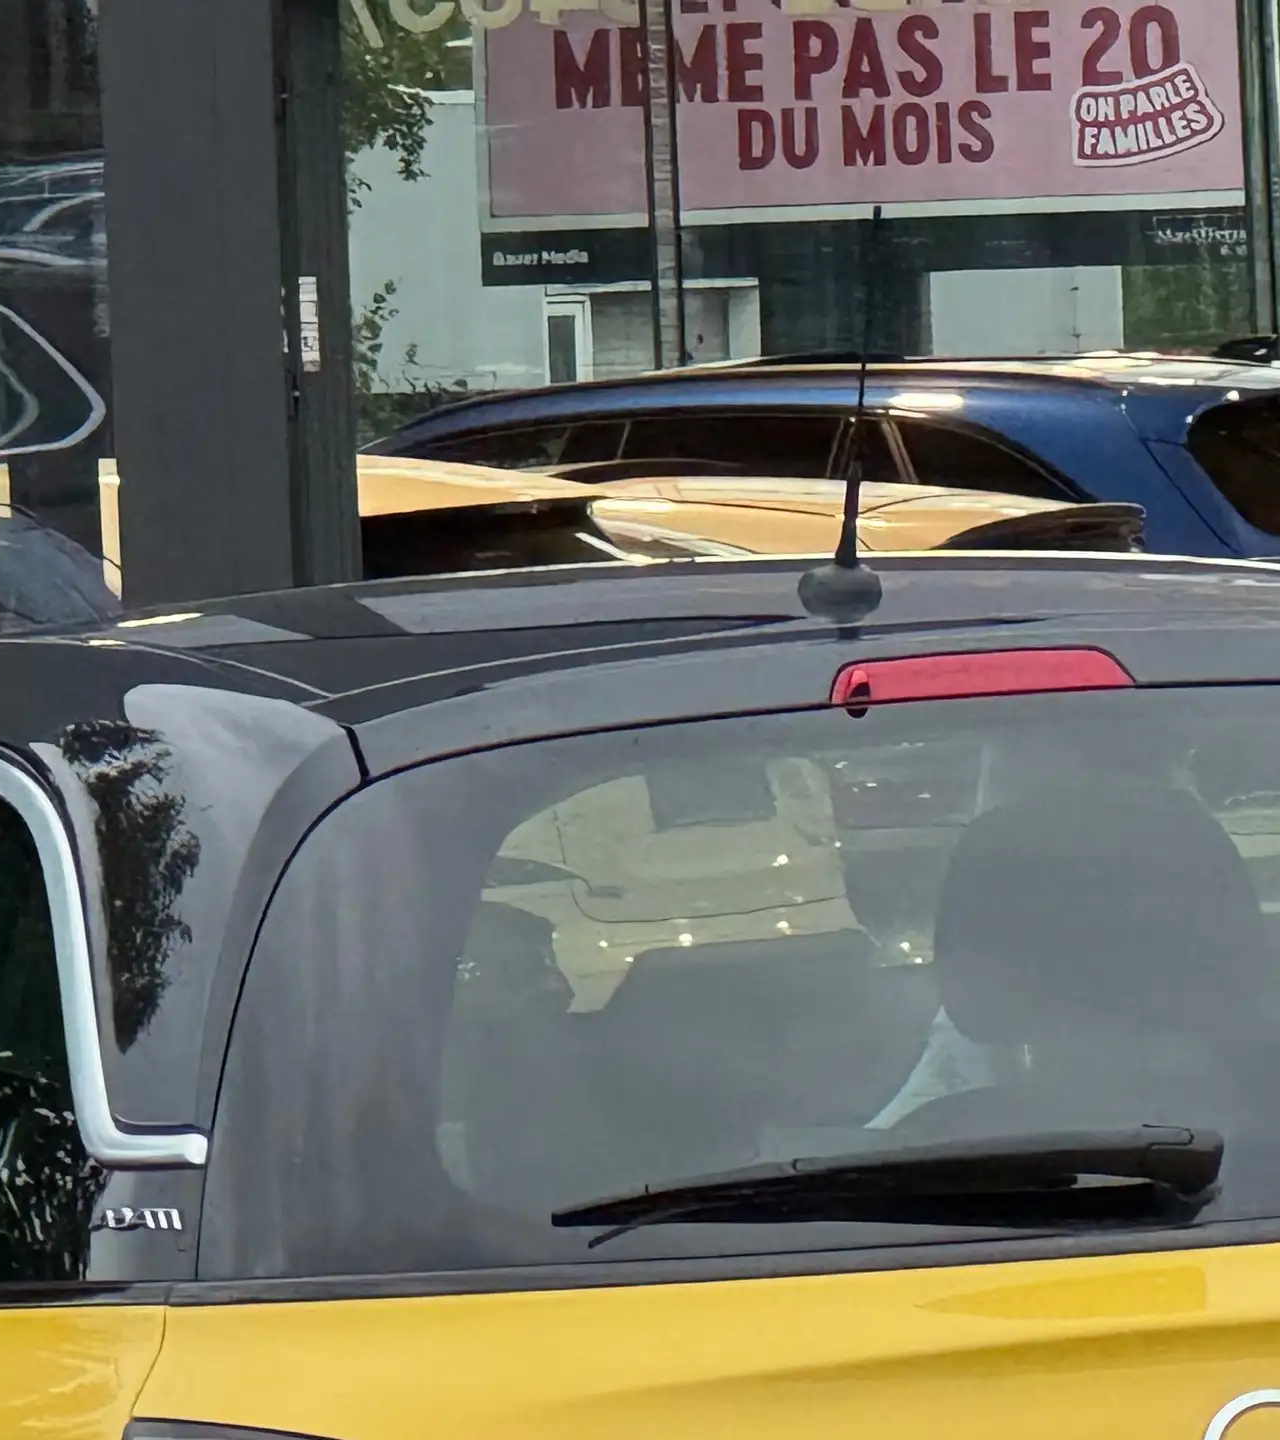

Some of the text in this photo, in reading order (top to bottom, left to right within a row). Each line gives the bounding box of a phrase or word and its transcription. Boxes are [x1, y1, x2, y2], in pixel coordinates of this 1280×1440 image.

[793, 15, 944, 99] PAS
[973, 11, 1052, 93] LE
[1080, 5, 1181, 87] 20
[1080, 74, 1195, 122] ON PARLE
[1083, 102, 1208, 155] FAMILLES
[737, 100, 995, 170] DU MOIS
